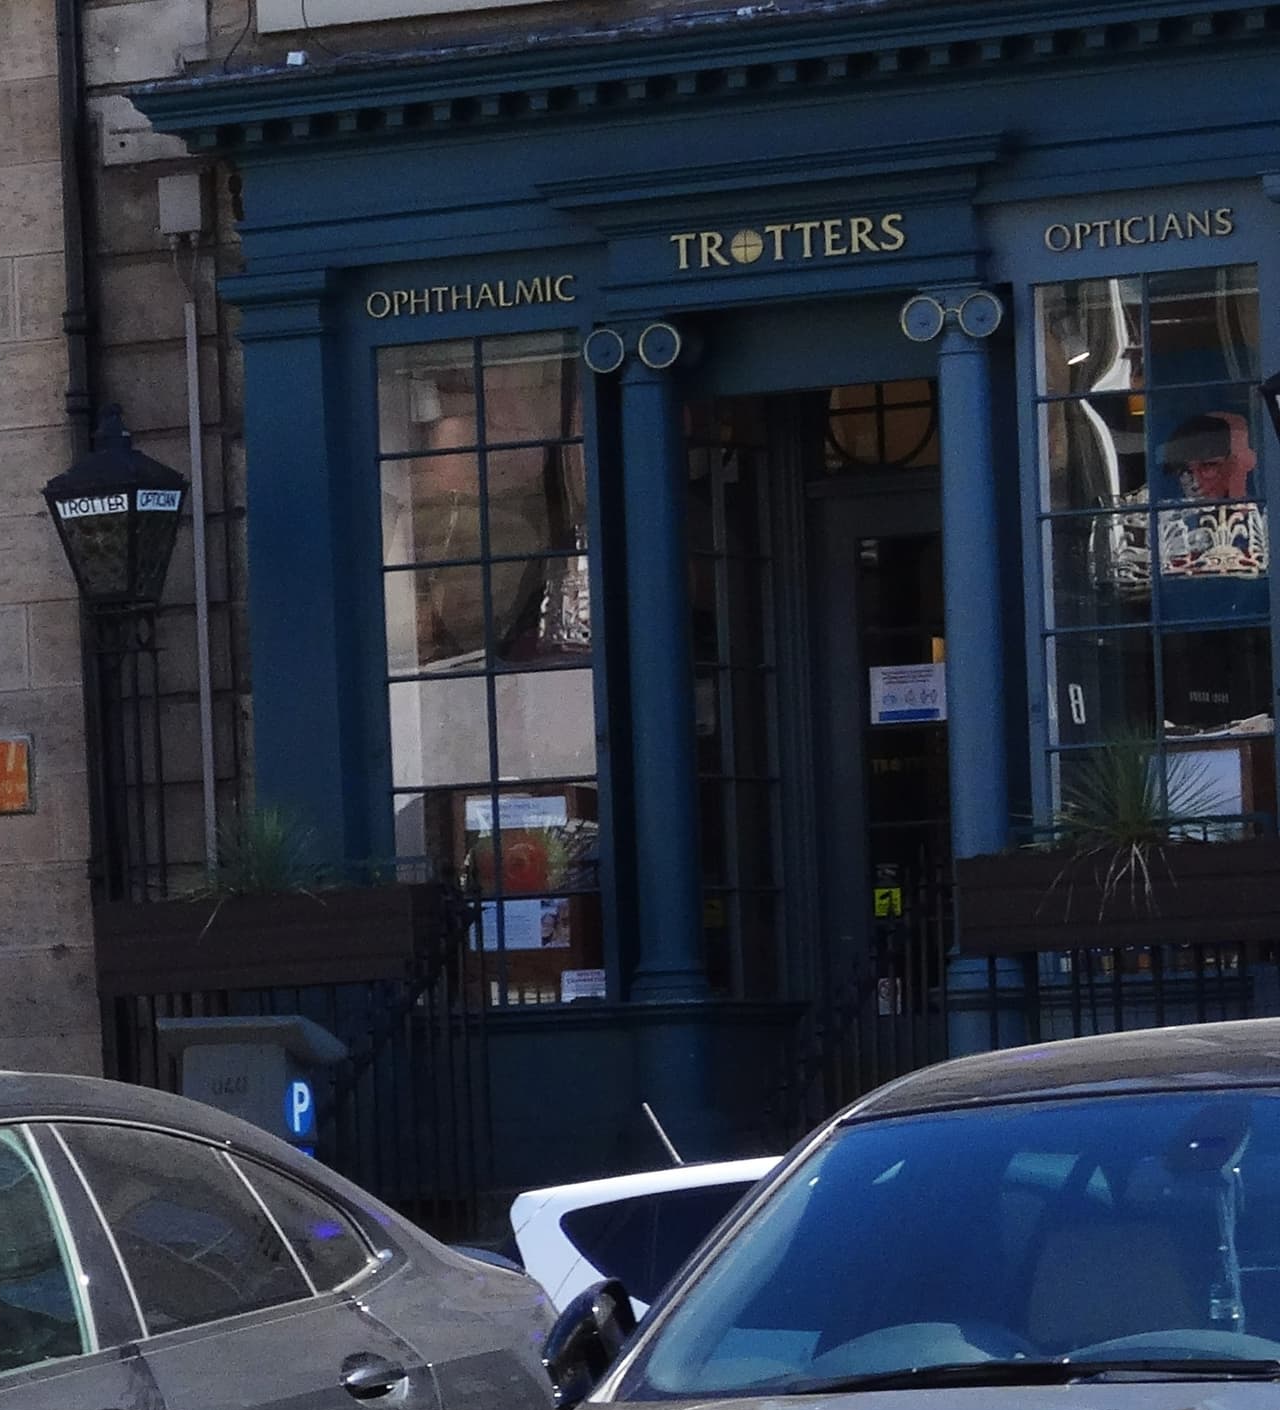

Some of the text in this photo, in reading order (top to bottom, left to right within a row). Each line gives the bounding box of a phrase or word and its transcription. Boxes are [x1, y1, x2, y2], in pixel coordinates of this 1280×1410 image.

[670, 212, 906, 270] TROTTERS
[1044, 208, 1233, 251] OPTICIANS
[366, 274, 576, 319] OPHTHALMIC
[292, 1081, 310, 1133] P
